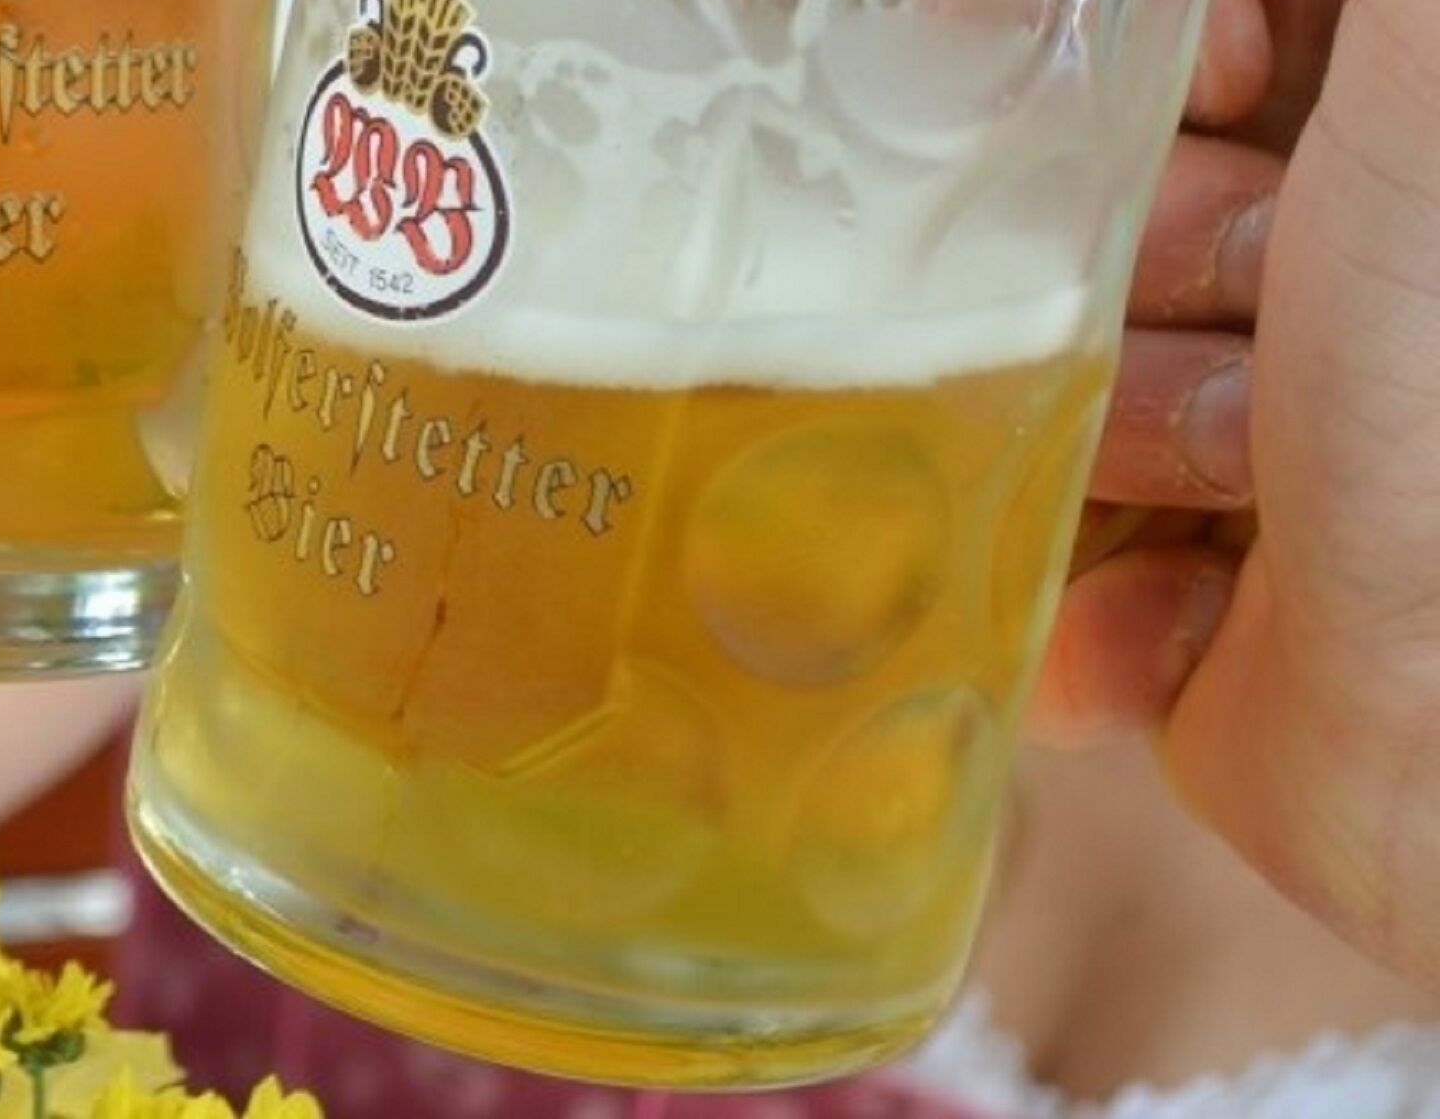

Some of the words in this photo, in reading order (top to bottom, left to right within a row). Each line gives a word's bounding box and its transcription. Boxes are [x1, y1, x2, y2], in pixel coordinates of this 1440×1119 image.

[322, 225, 361, 277] SEIT
[368, 267, 415, 295] 1542
[247, 442, 397, 596] Bier
